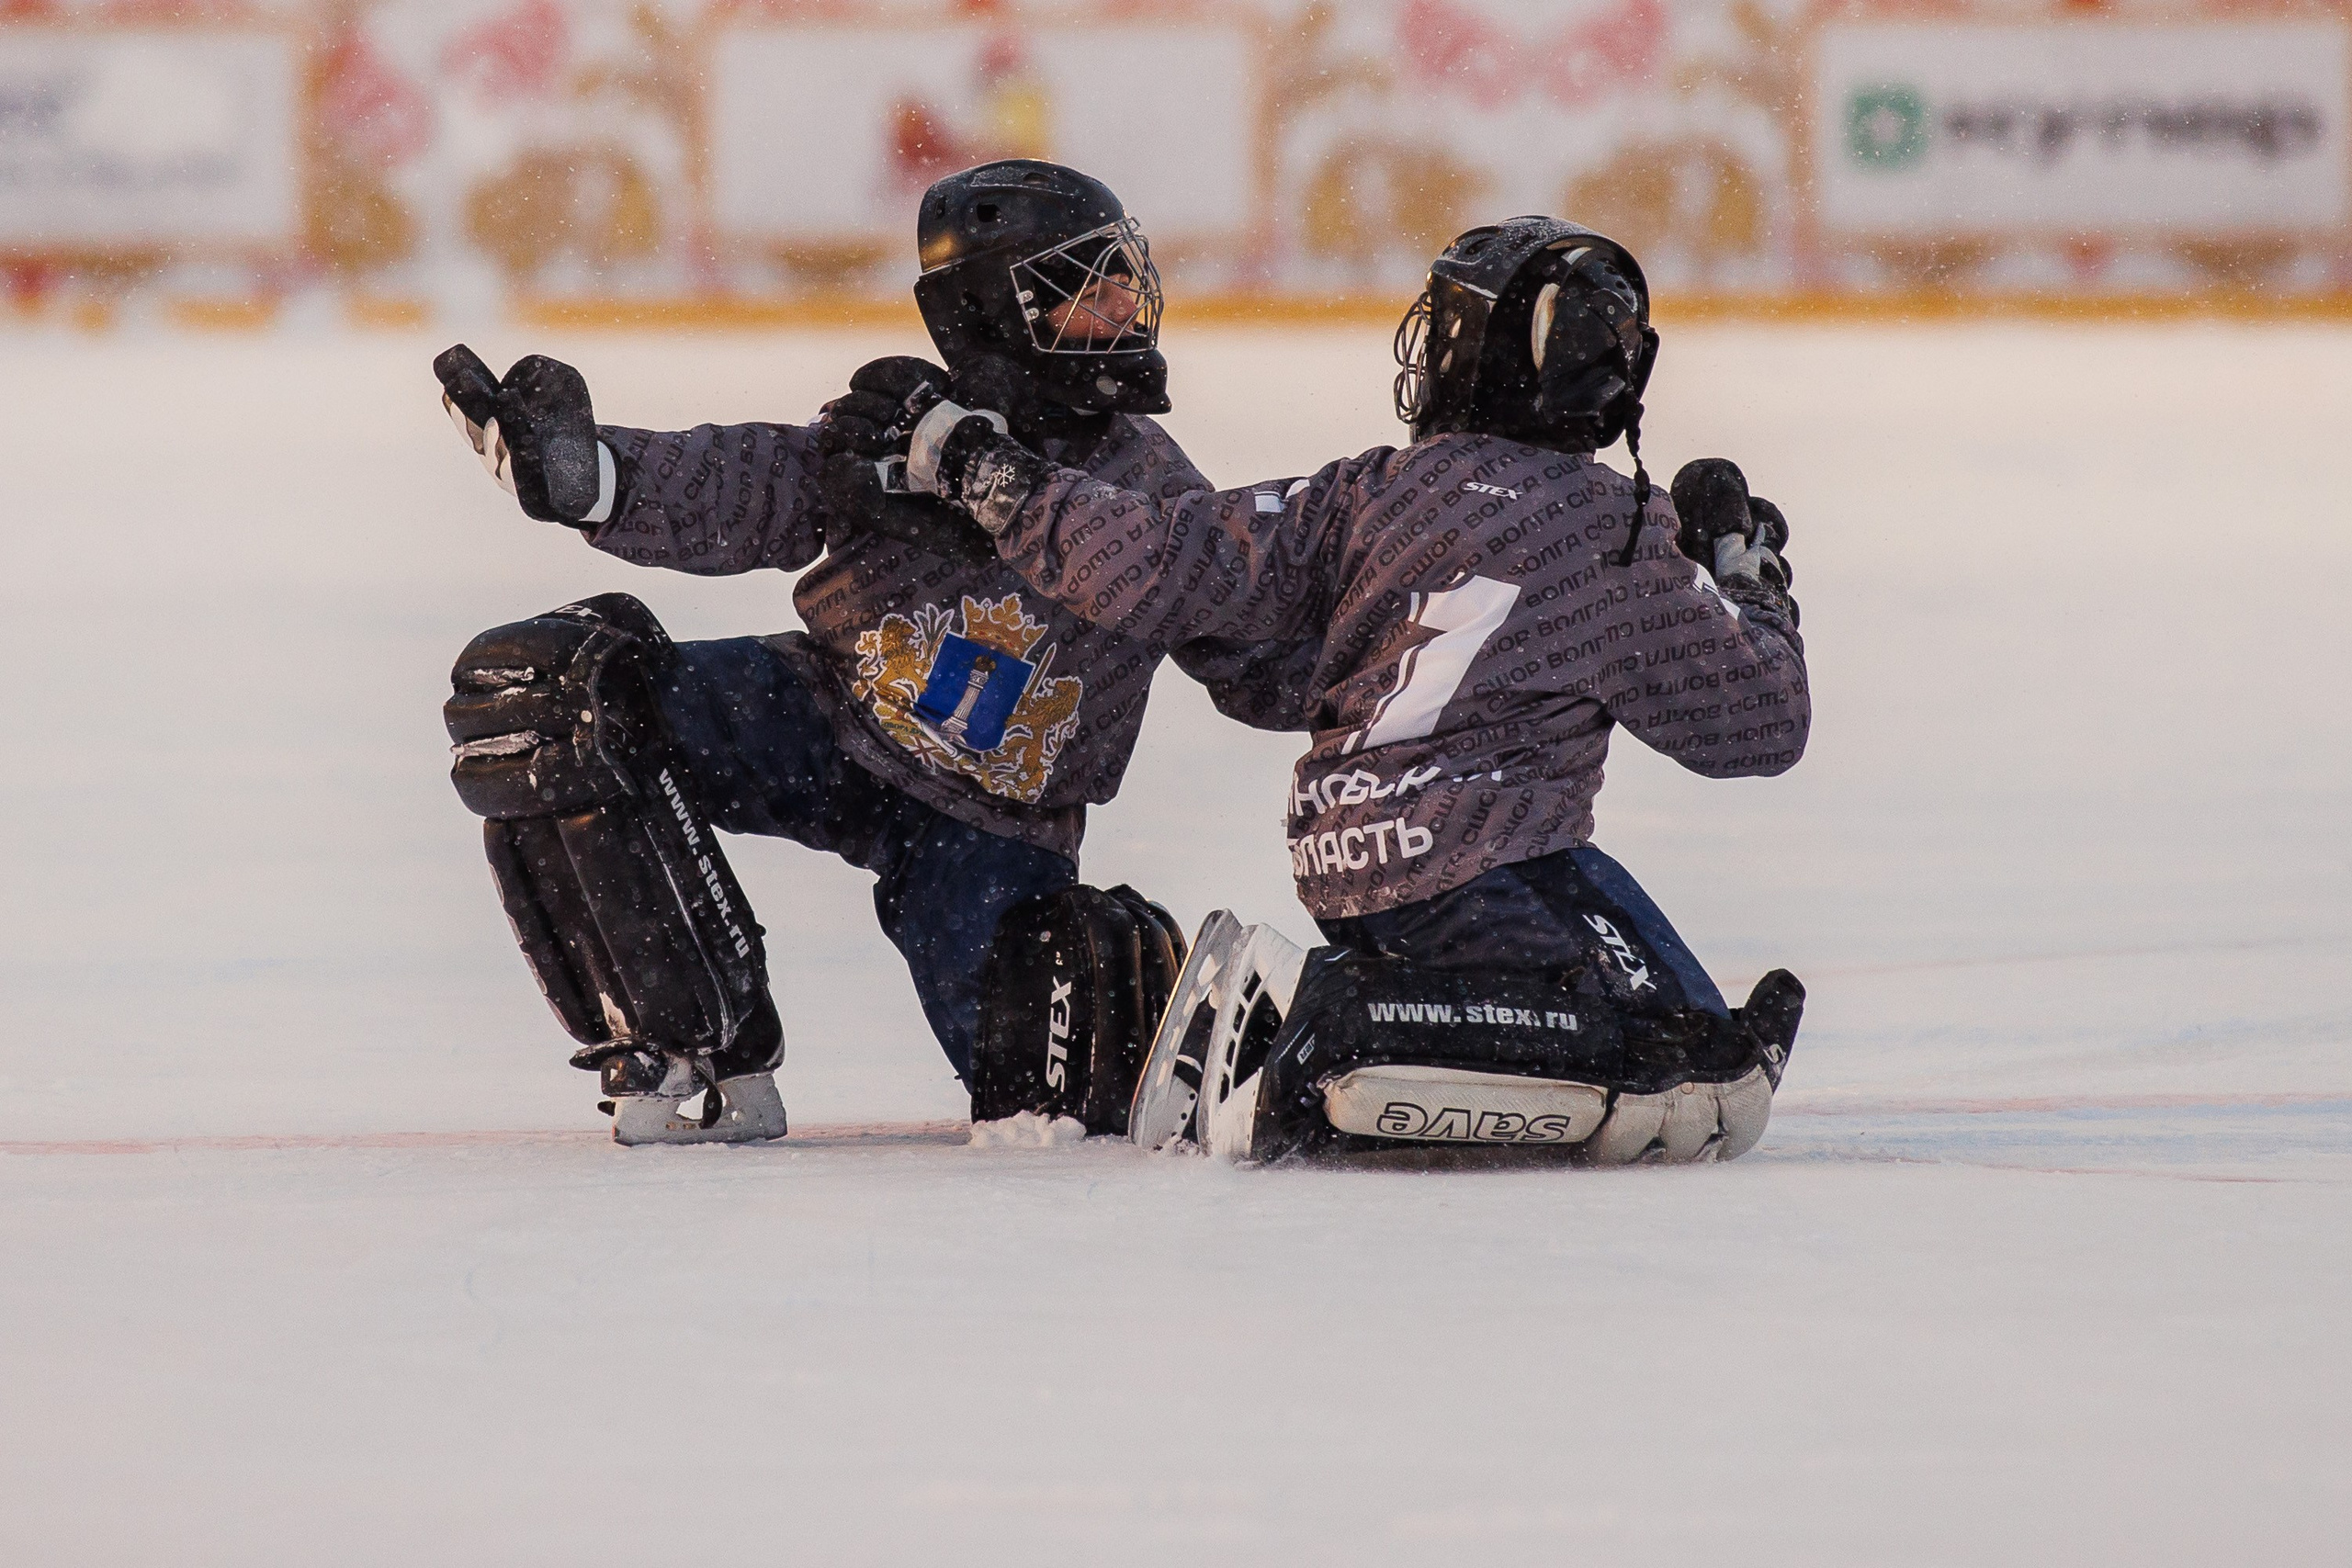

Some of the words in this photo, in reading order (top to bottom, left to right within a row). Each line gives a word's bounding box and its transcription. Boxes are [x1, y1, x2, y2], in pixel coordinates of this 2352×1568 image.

[1362, 488, 1419, 546] СШОР
[1419, 434, 1494, 488] ВОЛГА
[1464, 481, 1523, 500] STEX
[1378, 507, 1440, 567] СШОР
[1485, 501, 1565, 556] ВОЛГА
[1067, 538, 1124, 595] СШОР
[1398, 527, 1461, 588] СШОР
[1090, 564, 1143, 617] СШОР
[1524, 565, 1598, 609] ВОЛГА
[1536, 598, 1608, 638] ВОЛГА
[1472, 660, 1542, 698] СШОР
[1545, 635, 1607, 670] ВОЛГ
[1645, 637, 1716, 668] ВОЛГА
[1723, 750, 1795, 770] СШОР
[1046, 975, 1072, 1093] STEX
[1376, 1101, 1572, 1143] save
